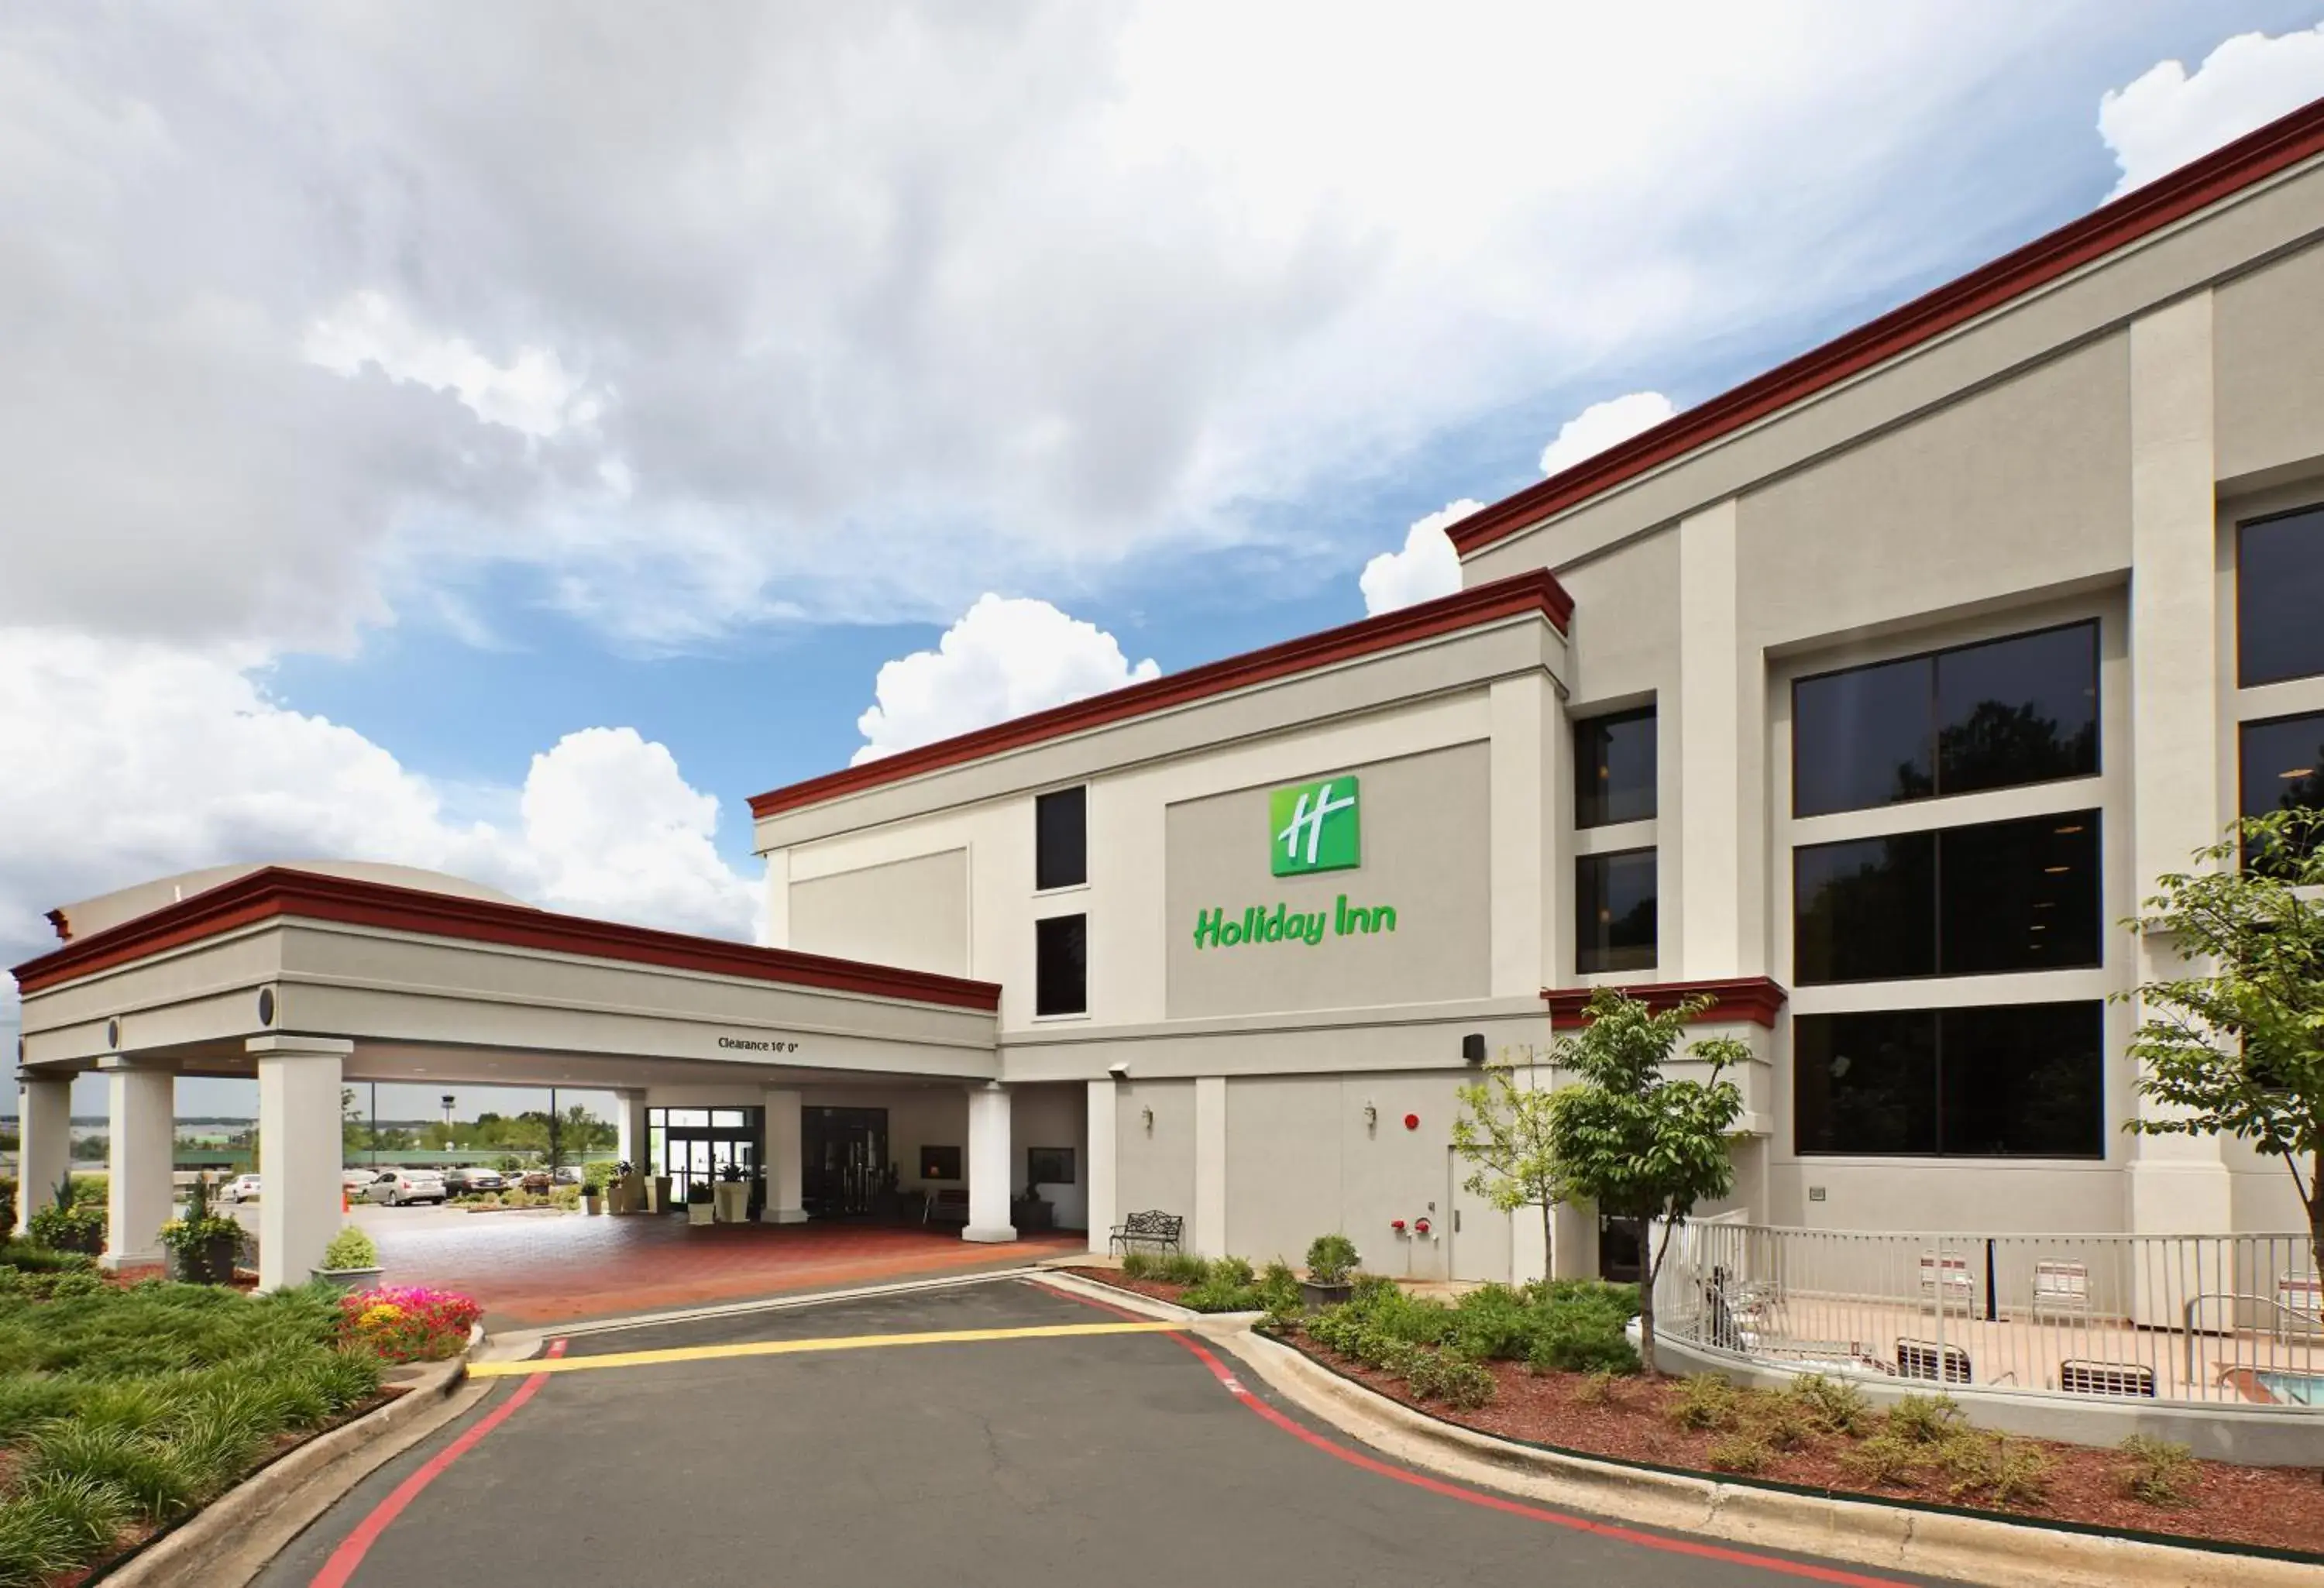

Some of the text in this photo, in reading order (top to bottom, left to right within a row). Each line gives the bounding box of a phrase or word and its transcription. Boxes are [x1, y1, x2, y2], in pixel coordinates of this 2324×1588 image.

[1278, 784, 1355, 864] H
[1194, 894, 1397, 950] Holiday Inn
[718, 1037, 769, 1051] Clearance
